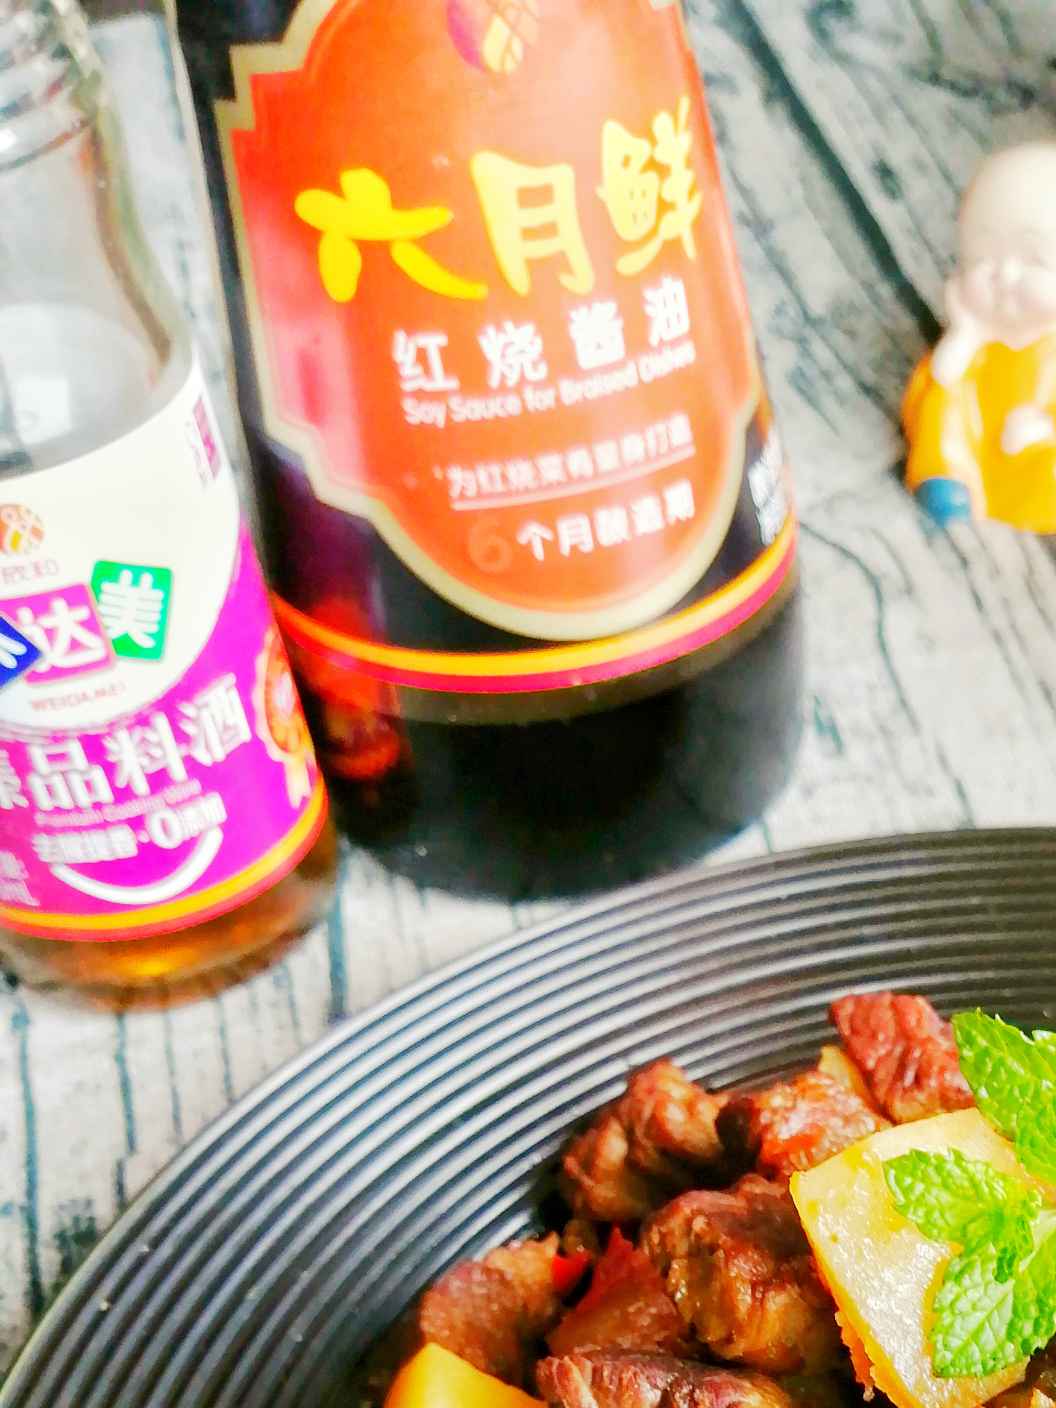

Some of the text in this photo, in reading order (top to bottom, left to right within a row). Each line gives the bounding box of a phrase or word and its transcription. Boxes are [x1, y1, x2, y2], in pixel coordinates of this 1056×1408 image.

[294, 97, 702, 303] 六月鲜
[392, 275, 690, 392] 红烧酱油
[403, 397, 447, 428] Soy
[449, 393, 522, 423] Sauce
